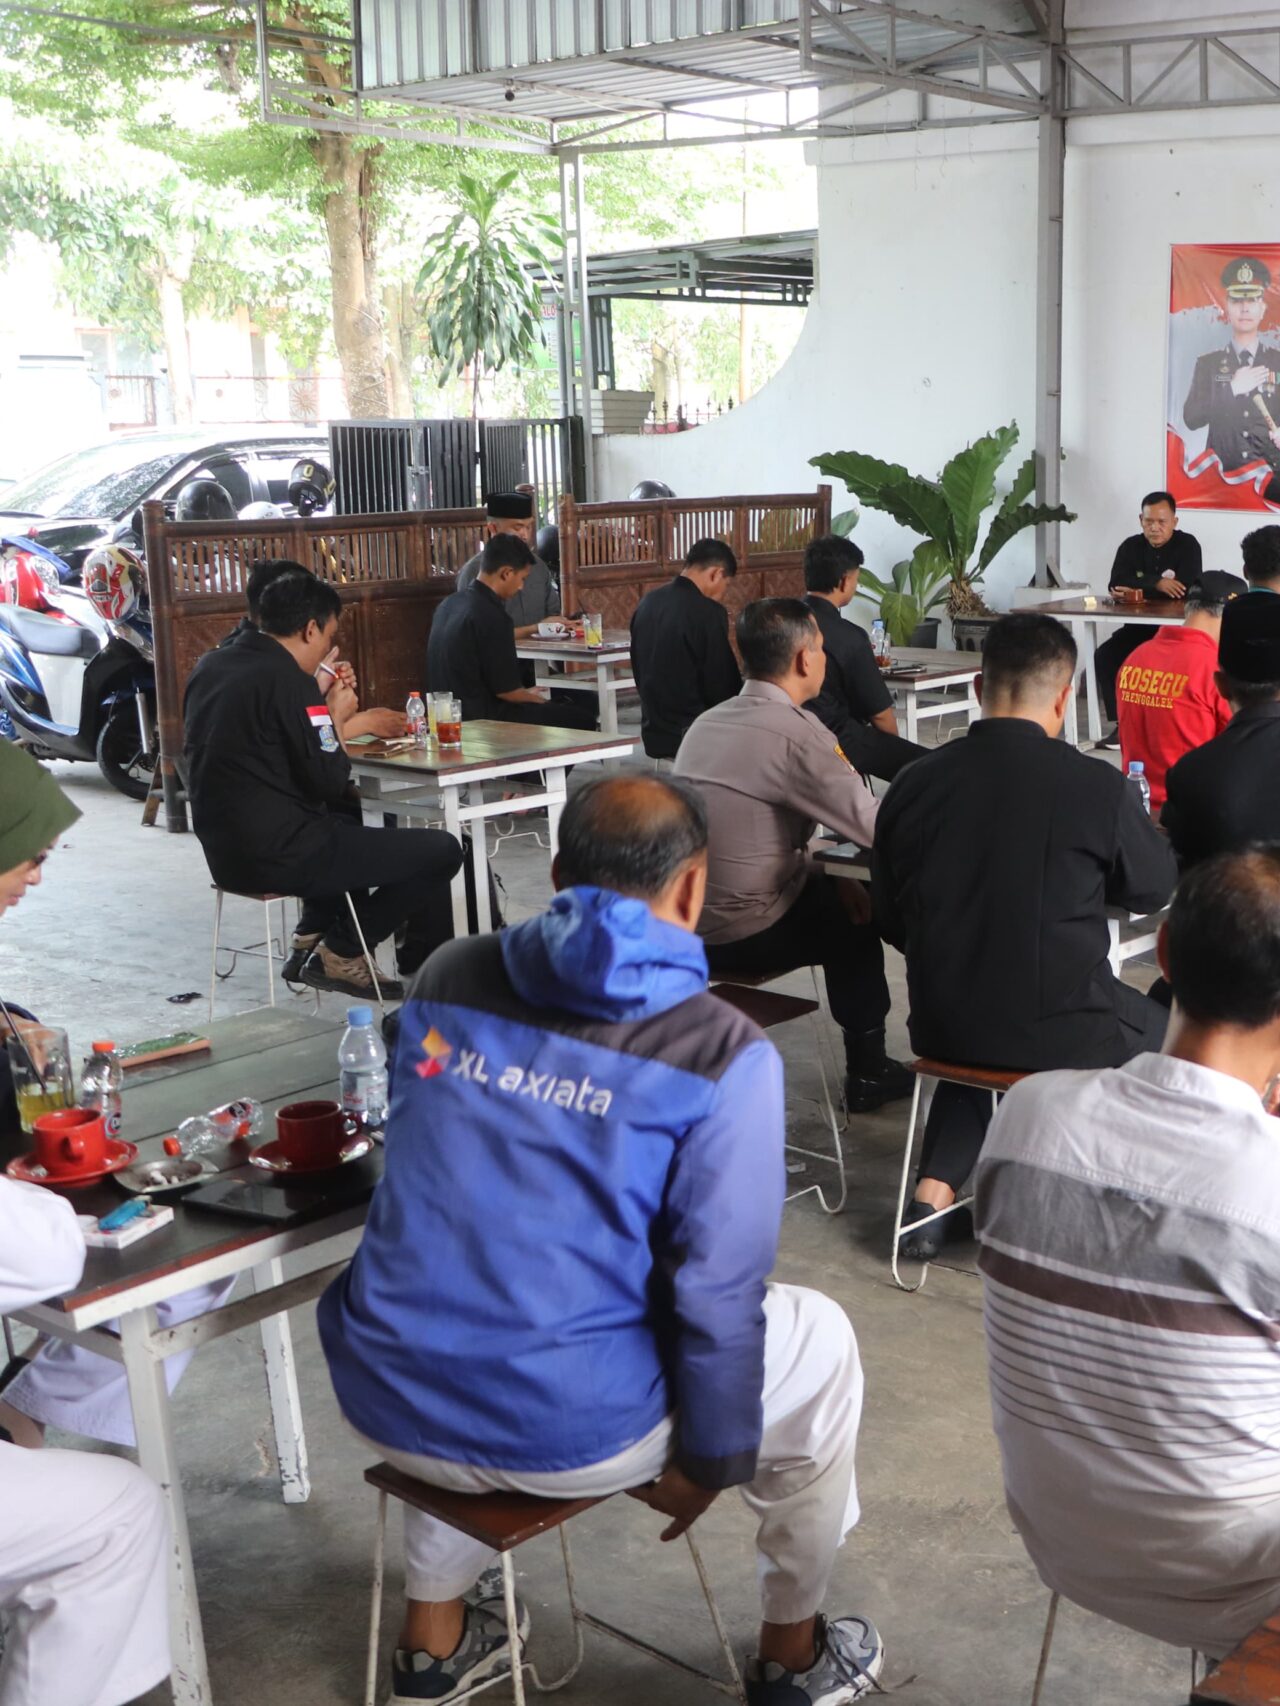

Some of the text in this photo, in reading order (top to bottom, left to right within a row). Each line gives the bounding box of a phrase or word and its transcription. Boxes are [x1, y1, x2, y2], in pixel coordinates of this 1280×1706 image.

[1119, 665, 1189, 698] KOSEGU
[1121, 690, 1174, 709] TRENGGALEK
[453, 1048, 613, 1117] XL axiata
